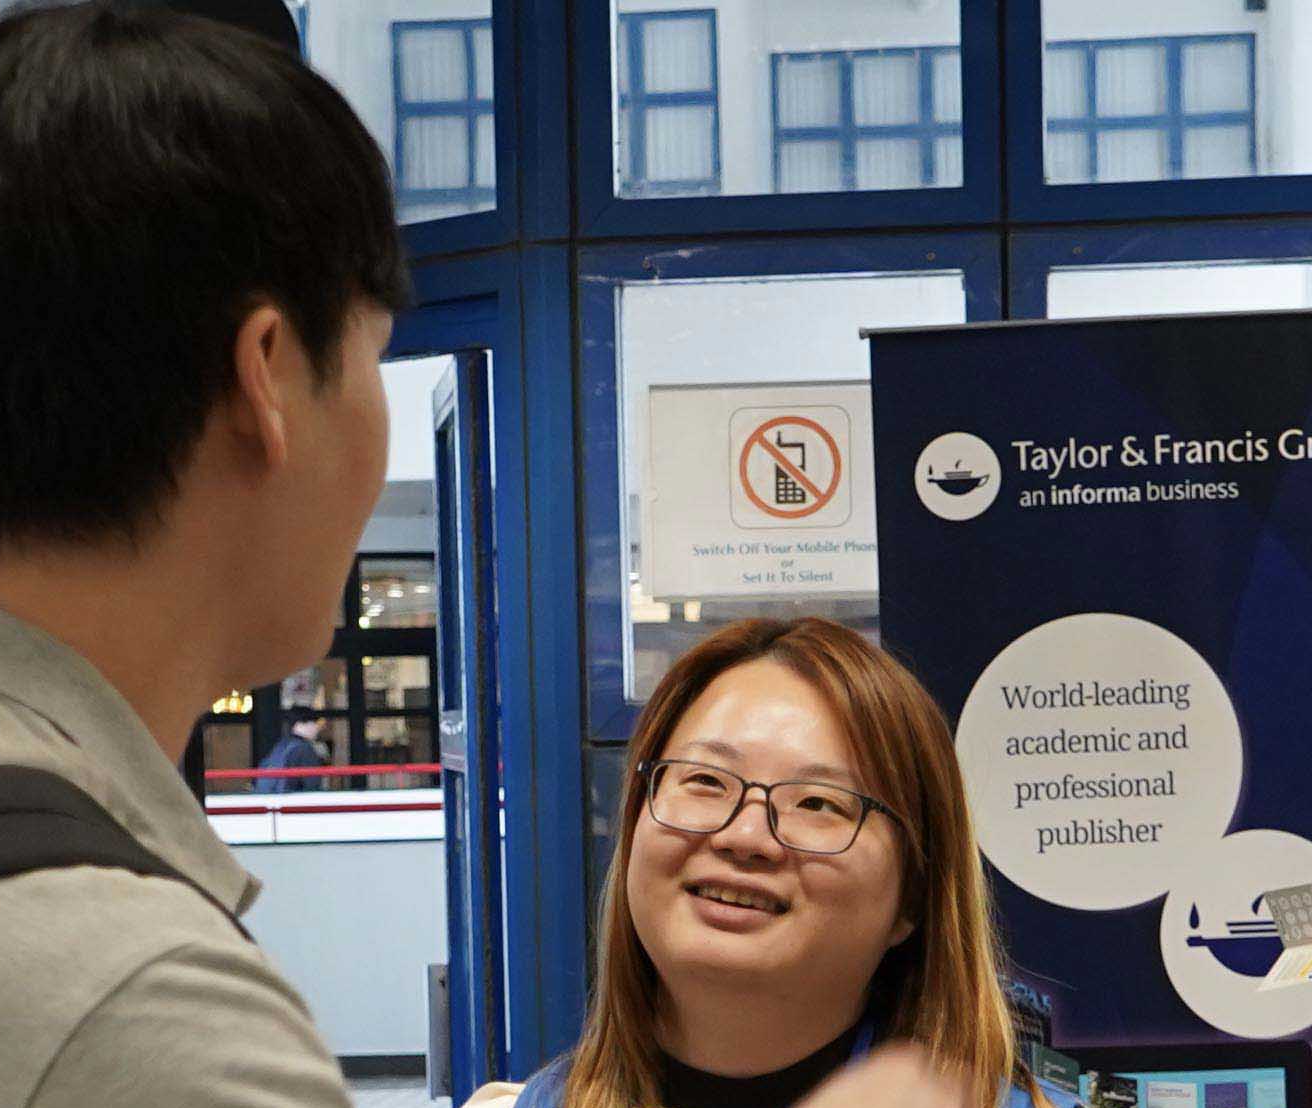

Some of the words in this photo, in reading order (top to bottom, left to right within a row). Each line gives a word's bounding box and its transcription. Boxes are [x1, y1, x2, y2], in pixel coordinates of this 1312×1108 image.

[1012, 439, 1113, 479] Taylor
[1120, 436, 1148, 467] &
[1155, 431, 1269, 465] Francis
[1019, 487, 1046, 507] an
[1050, 483, 1141, 504] informa
[1146, 478, 1240, 501] business
[693, 543, 736, 556] Switch
[739, 543, 760, 555] Off
[764, 542, 793, 554] Your
[797, 540, 840, 553] Mobile
[844, 540, 877, 552] Phon
[743, 572, 762, 583] Set
[766, 572, 775, 582] It
[780, 571, 795, 582] To
[798, 570, 833, 581] Silent
[1001, 678, 1191, 711] World-leading
[1006, 728, 1131, 756] academic
[1138, 724, 1189, 750] and
[1014, 770, 1177, 810] professional
[1037, 817, 1163, 854] publisher
